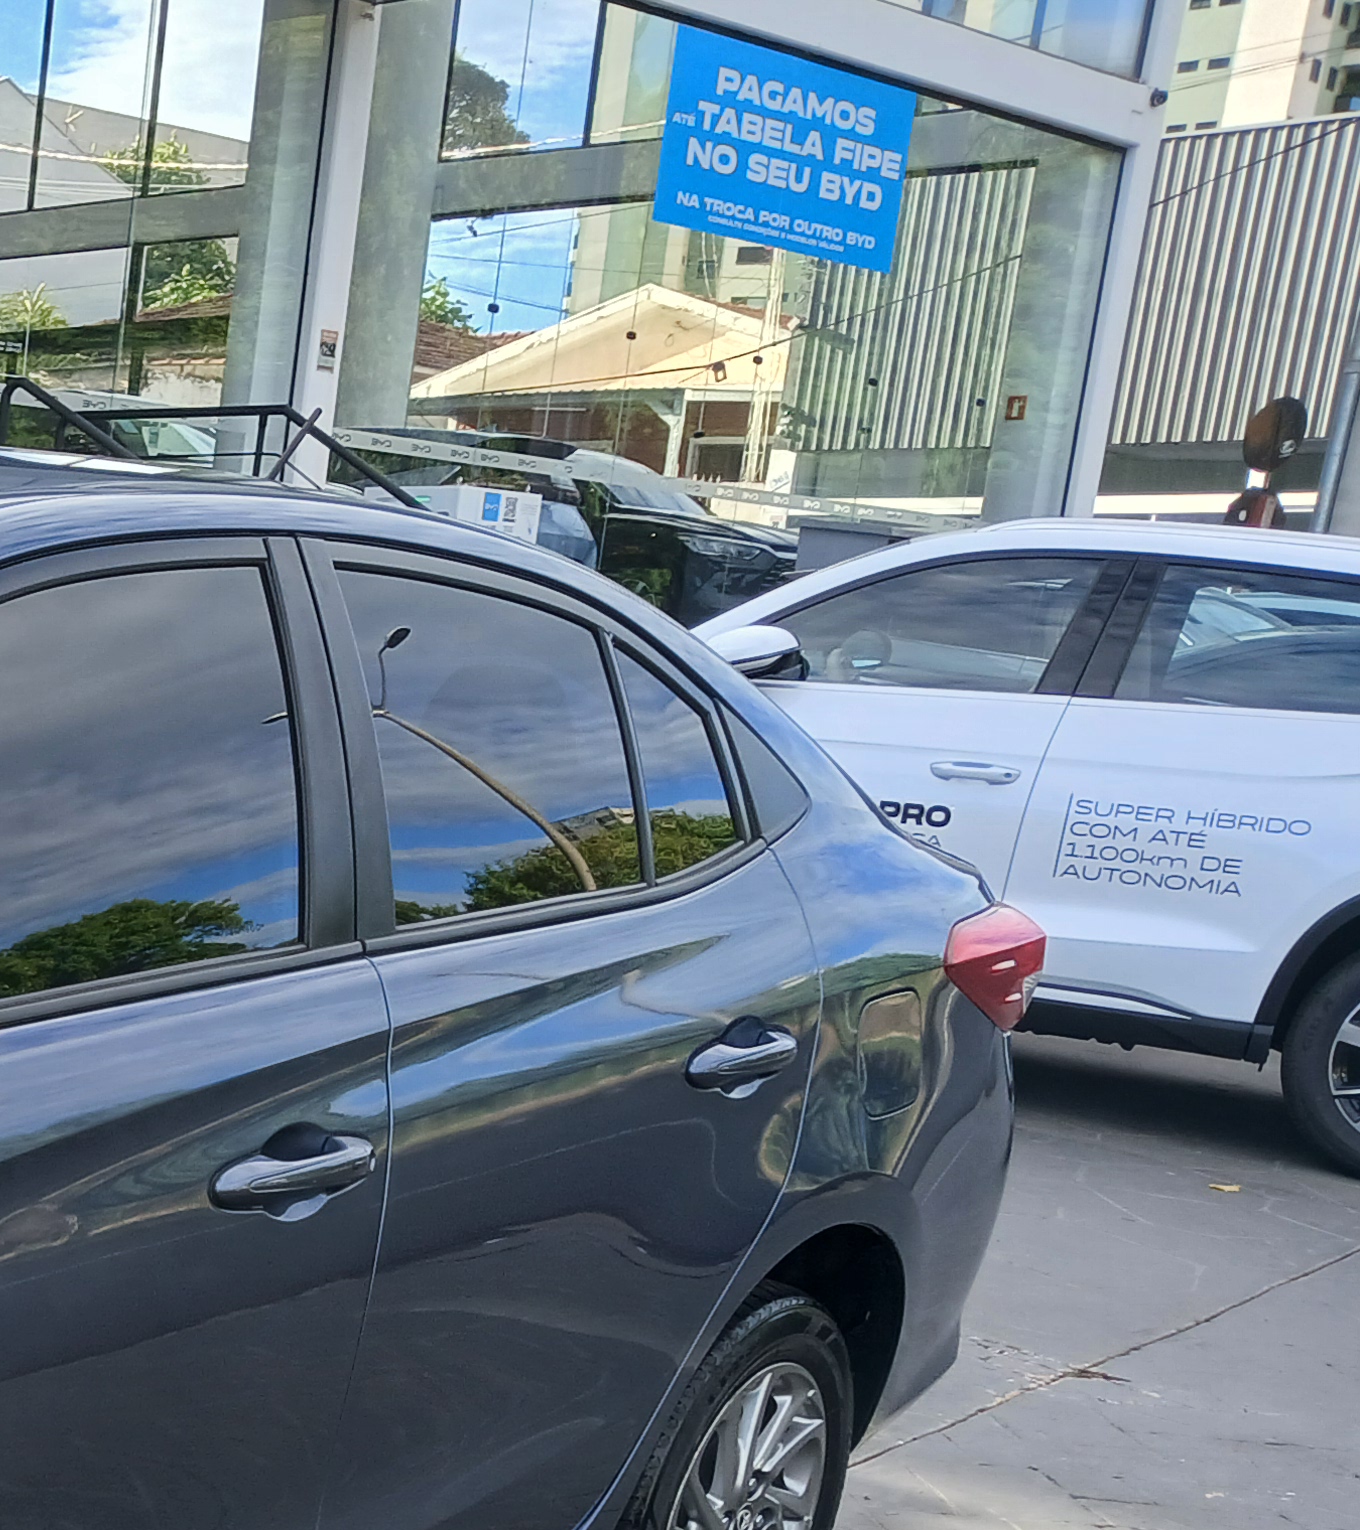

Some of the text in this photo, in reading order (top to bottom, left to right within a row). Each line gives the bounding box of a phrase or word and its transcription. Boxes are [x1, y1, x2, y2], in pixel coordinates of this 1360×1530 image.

[716, 66, 877, 136] PAGAMOS
[672, 100, 903, 181] ATÉ TABELA FIPE
[686, 136, 883, 212] NO SEU BYD
[676, 190, 876, 249] NA TROCA POR OUTRO BYD
[880, 799, 951, 829] PRO
[1074, 799, 1312, 836] SUPER HÍBRIDO
[1070, 821, 1208, 849] COM ATÉ
[1064, 842, 1243, 875] 1.100km DE
[1059, 864, 1242, 897] AUTONOMIA
